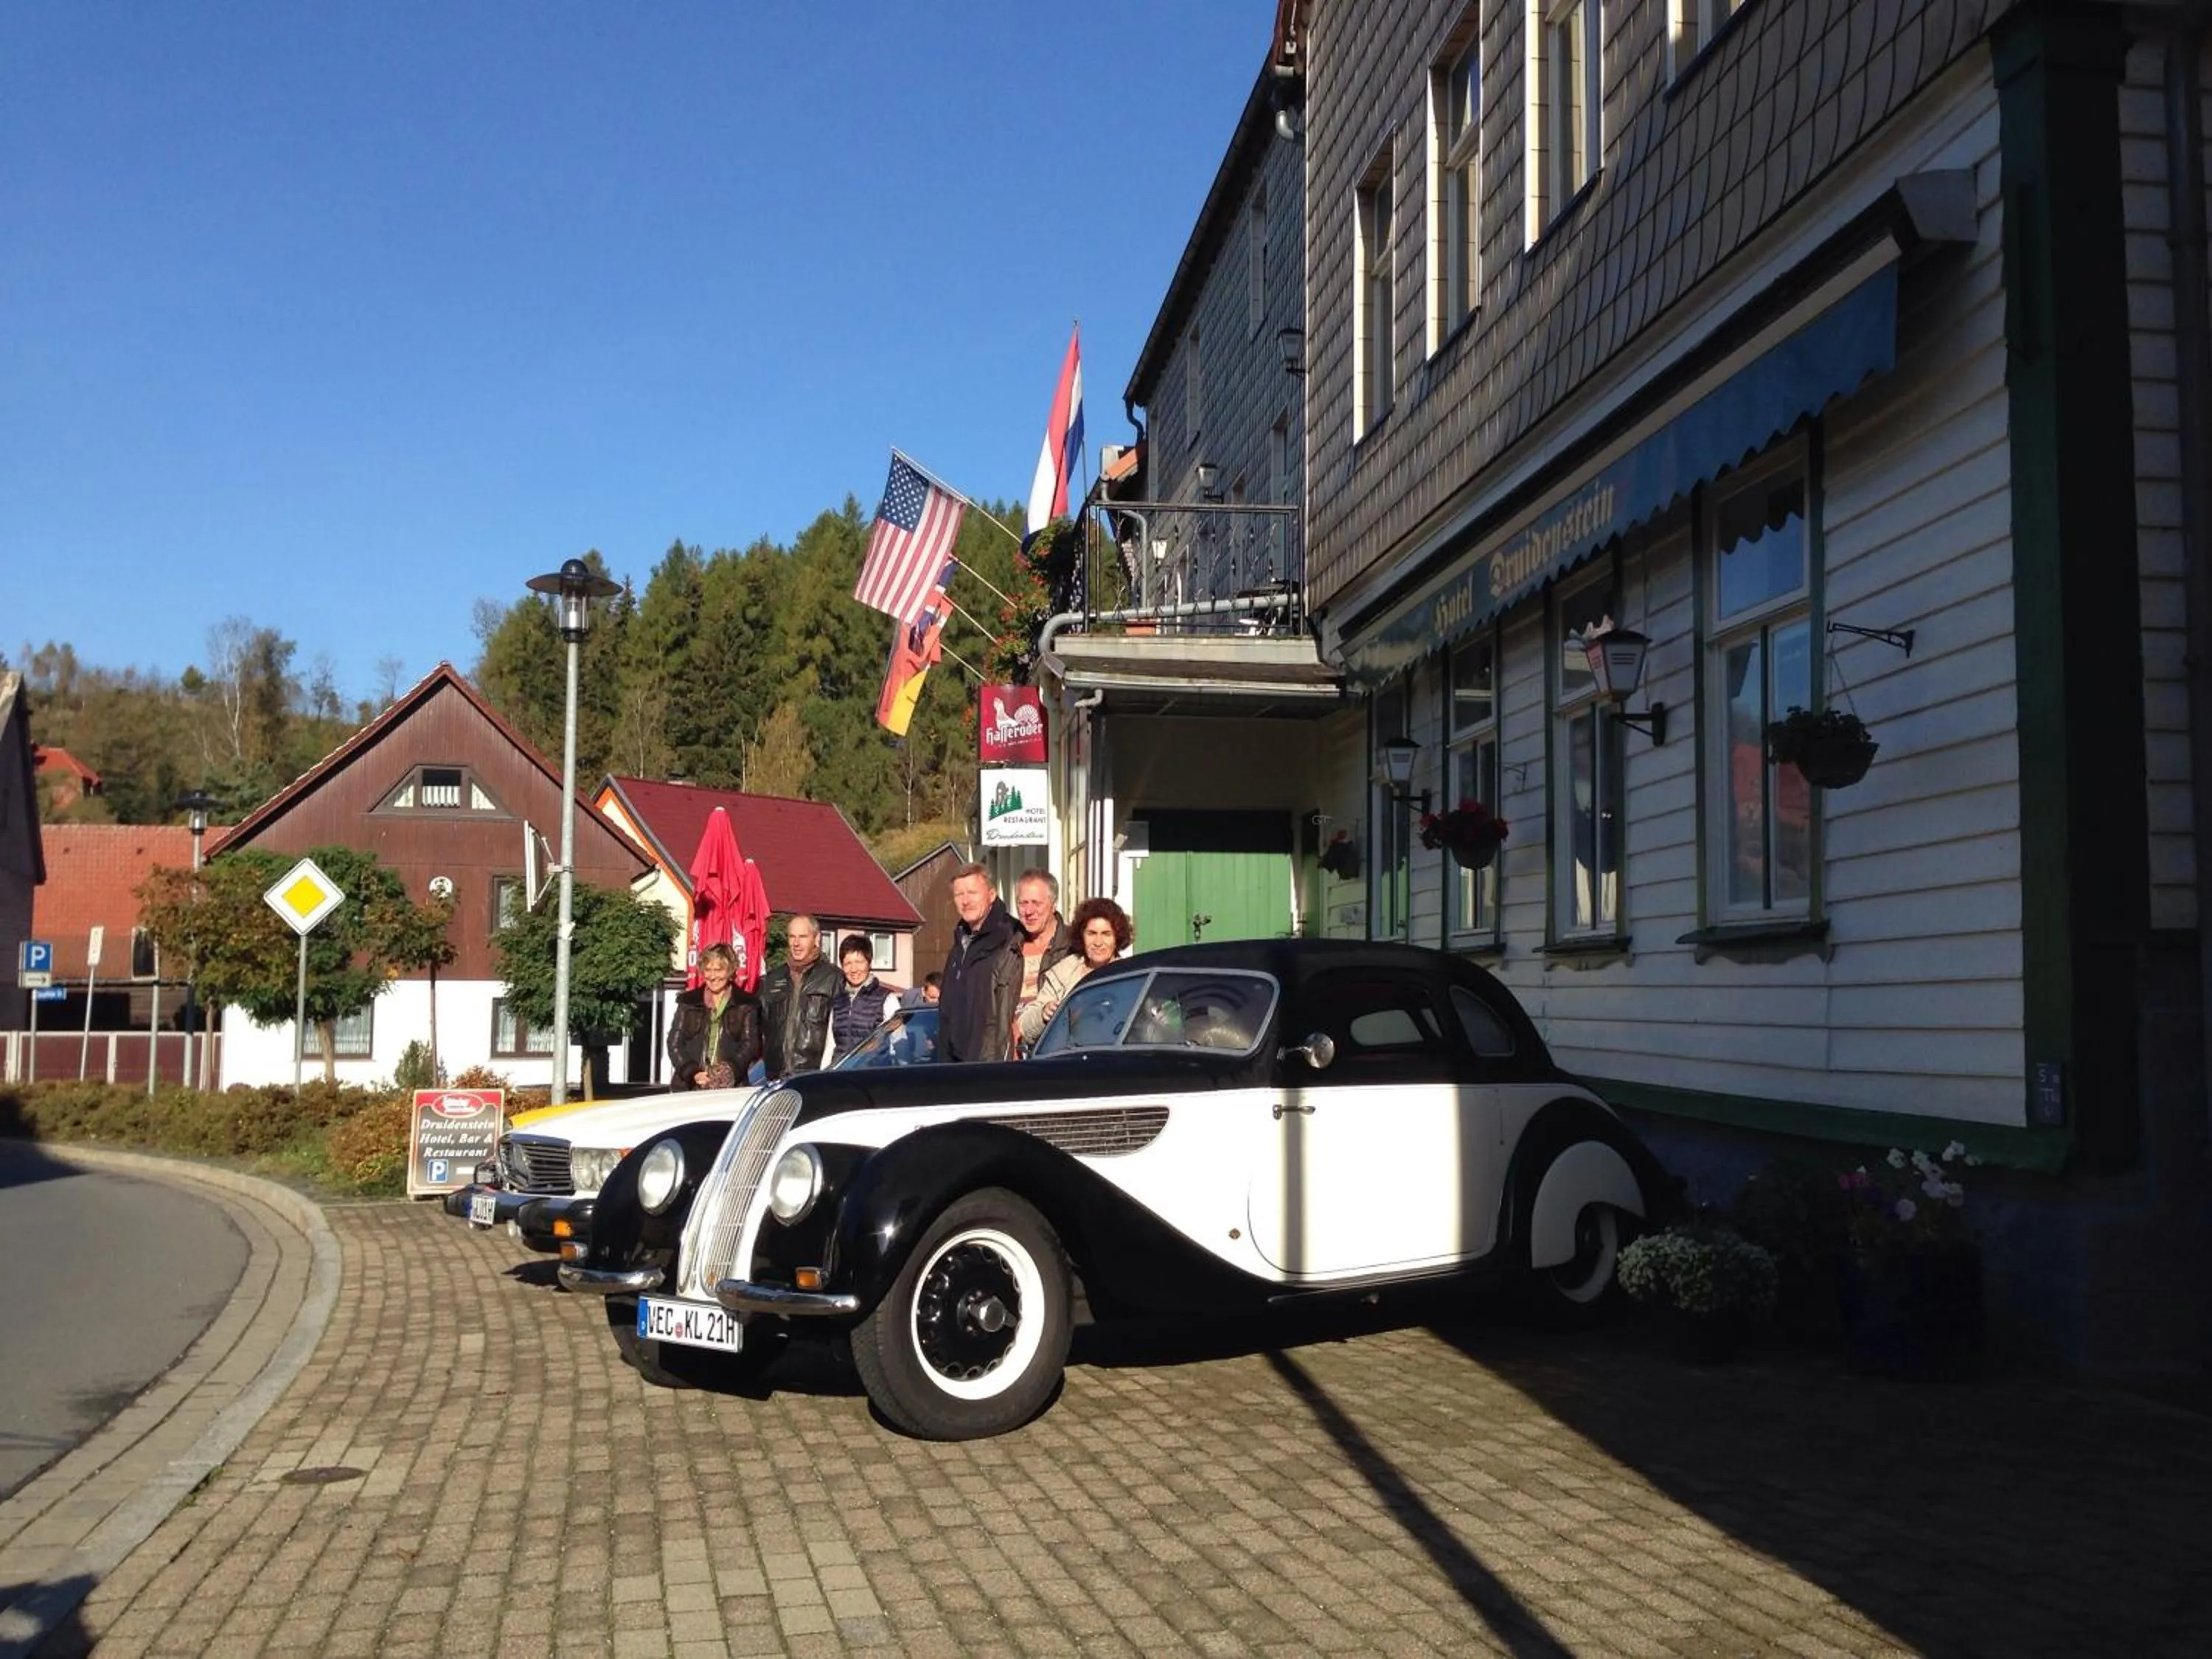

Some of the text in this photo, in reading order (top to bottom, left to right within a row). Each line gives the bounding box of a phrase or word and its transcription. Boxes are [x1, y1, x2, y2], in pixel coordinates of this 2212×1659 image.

[30, 946, 46, 968] P
[420, 1119, 495, 1130] Druidenstein
[419, 1133, 494, 1145] Hotel, Bar &
[423, 1147, 488, 1158] Restaurant
[431, 1161, 446, 1182] P
[648, 1305, 735, 1344] VEC KL 21H
